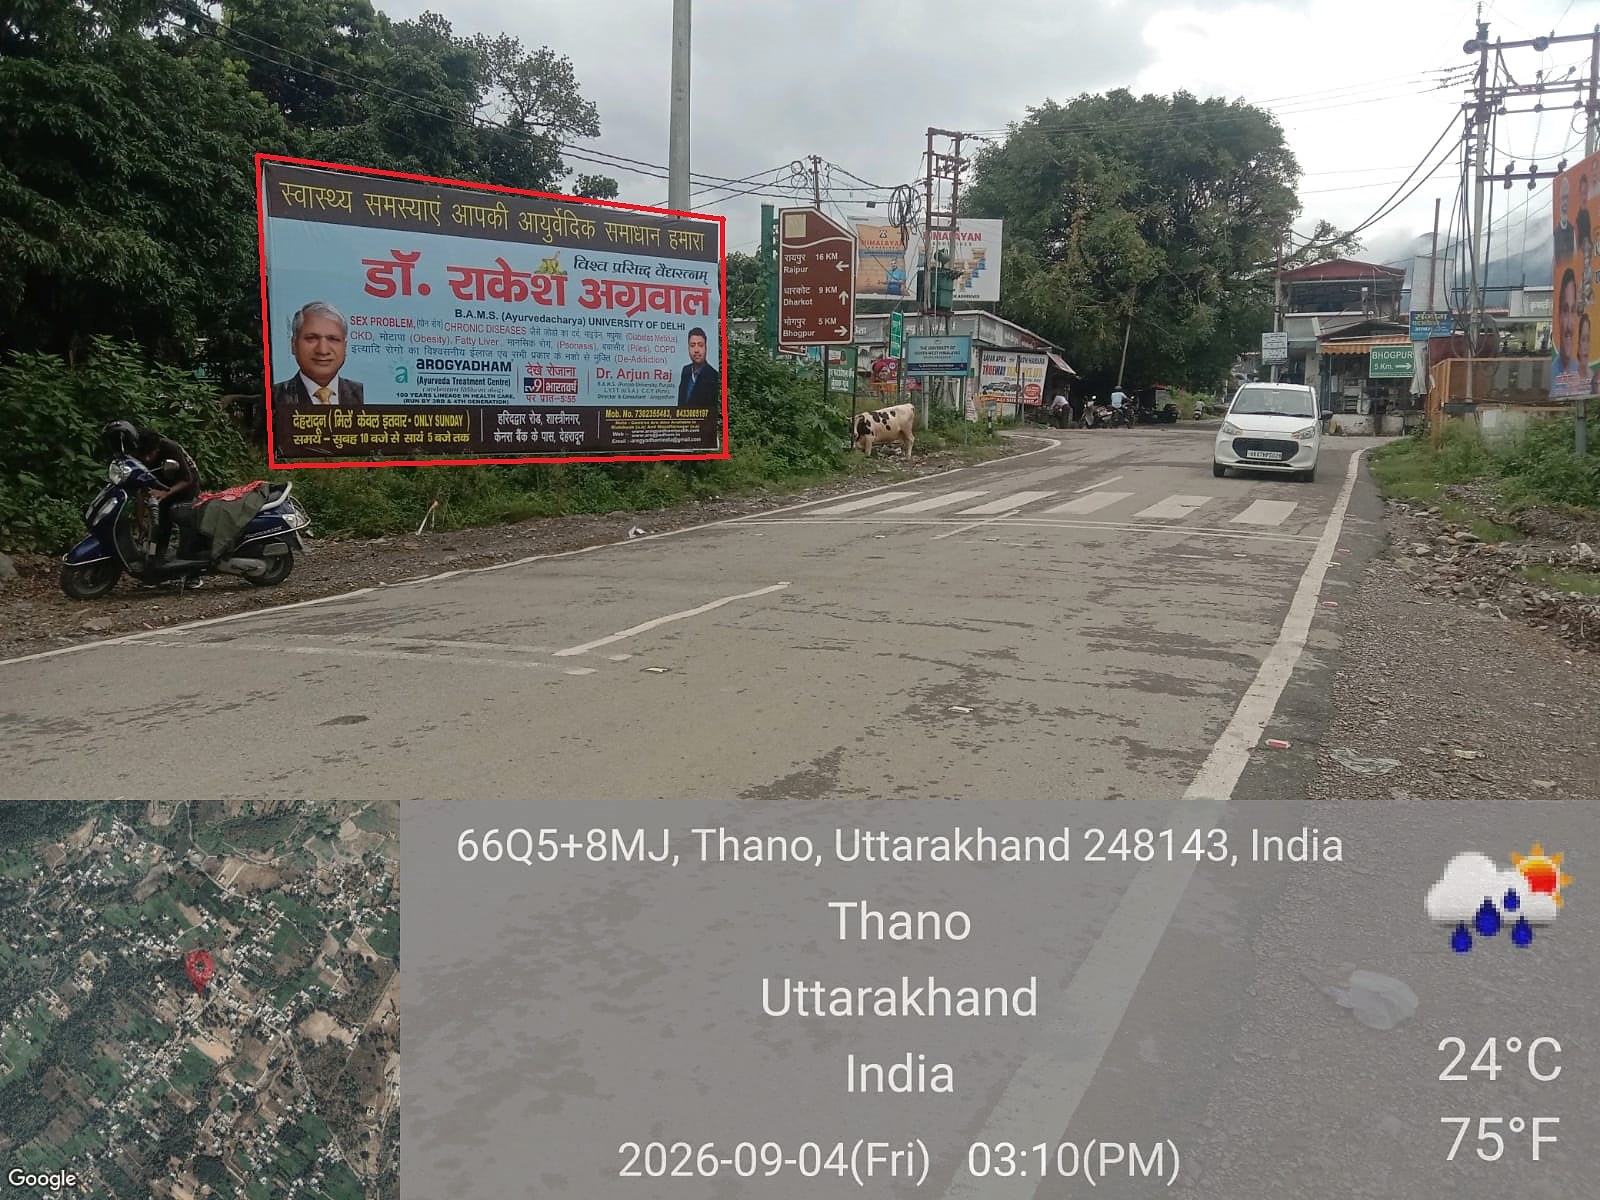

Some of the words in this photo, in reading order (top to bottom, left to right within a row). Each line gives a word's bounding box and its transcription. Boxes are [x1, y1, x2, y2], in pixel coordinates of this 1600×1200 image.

[279, 182, 353, 214] स्वास्थ्य
[363, 194, 441, 227] समस्याएं
[451, 201, 509, 231] आपकी
[518, 208, 596, 243] आयुर्वेदिक
[604, 221, 661, 248] समाधान
[668, 230, 705, 252] हमारा
[815, 253, 824, 261] 16
[825, 252, 838, 260] KM
[573, 254, 608, 273] विश्व
[783, 266, 809, 275] Raipur
[361, 249, 431, 299] डॉ.
[446, 257, 569, 306] राकेश
[577, 278, 712, 318] अग्रवाल
[818, 286, 824, 294] 9
[825, 286, 838, 294] KM
[783, 298, 813, 306] Dharkot
[350, 315, 368, 326] SEX
[454, 308, 499, 320] B.A.M.S.
[501, 311, 586, 327] (Ayurvedacharya)
[588, 317, 645, 329] UNIVERSITY
[645, 320, 659, 329] OF
[660, 321, 686, 331] DELHI
[818, 317, 823, 325] 5
[824, 317, 837, 325] KM
[444, 321, 484, 333] CHRONIC
[486, 324, 527, 335] DISEASES
[783, 329, 816, 339] Bhogpur
[1372, 351, 1413, 360] BHOGPUR
[596, 367, 613, 379] Dr.
[616, 367, 652, 382] Arjun
[654, 368, 673, 383] Raj
[292, 409, 327, 435] देहरादून
[356, 409, 380, 428] केवल
[413, 414, 433, 427] ONLY
[292, 434, 322, 445] समय
[332, 434, 359, 449] सुबह
[433, 430, 451, 443] बजे
[452, 433, 471, 443] तक
[531, 428, 539, 442] के
[558, 428, 584, 446] देहरादून
